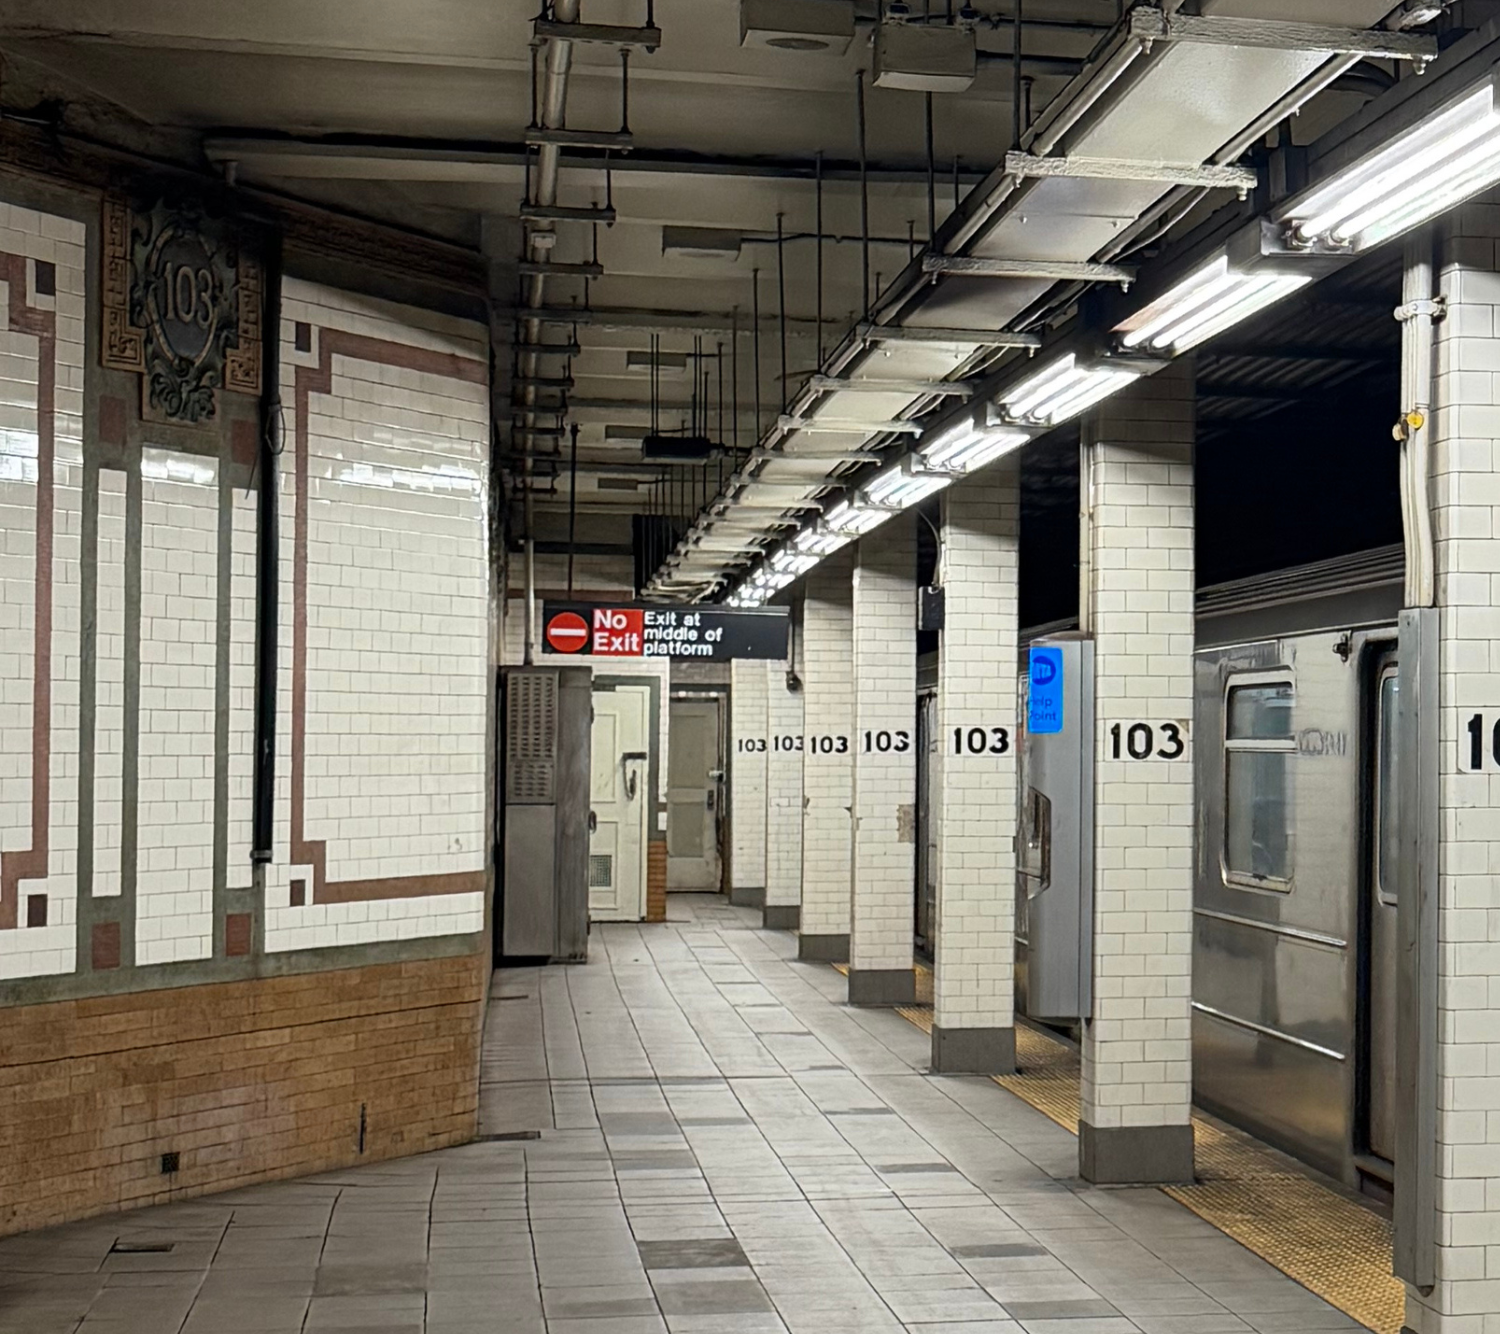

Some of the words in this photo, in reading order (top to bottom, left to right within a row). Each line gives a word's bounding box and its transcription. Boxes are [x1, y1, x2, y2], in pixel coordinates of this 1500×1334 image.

[164, 261, 214, 328] 103
[593, 610, 628, 630] No
[644, 611, 677, 626] Exit
[683, 612, 701, 627] at
[593, 632, 639, 652] Exit
[643, 626, 699, 641] middle
[704, 626, 724, 642] of
[643, 642, 714, 656] platform
[737, 738, 768, 753] 103
[811, 736, 849, 754] 103
[864, 730, 910, 753] 103
[953, 727, 1010, 755] 103
[1110, 722, 1185, 760] 103
